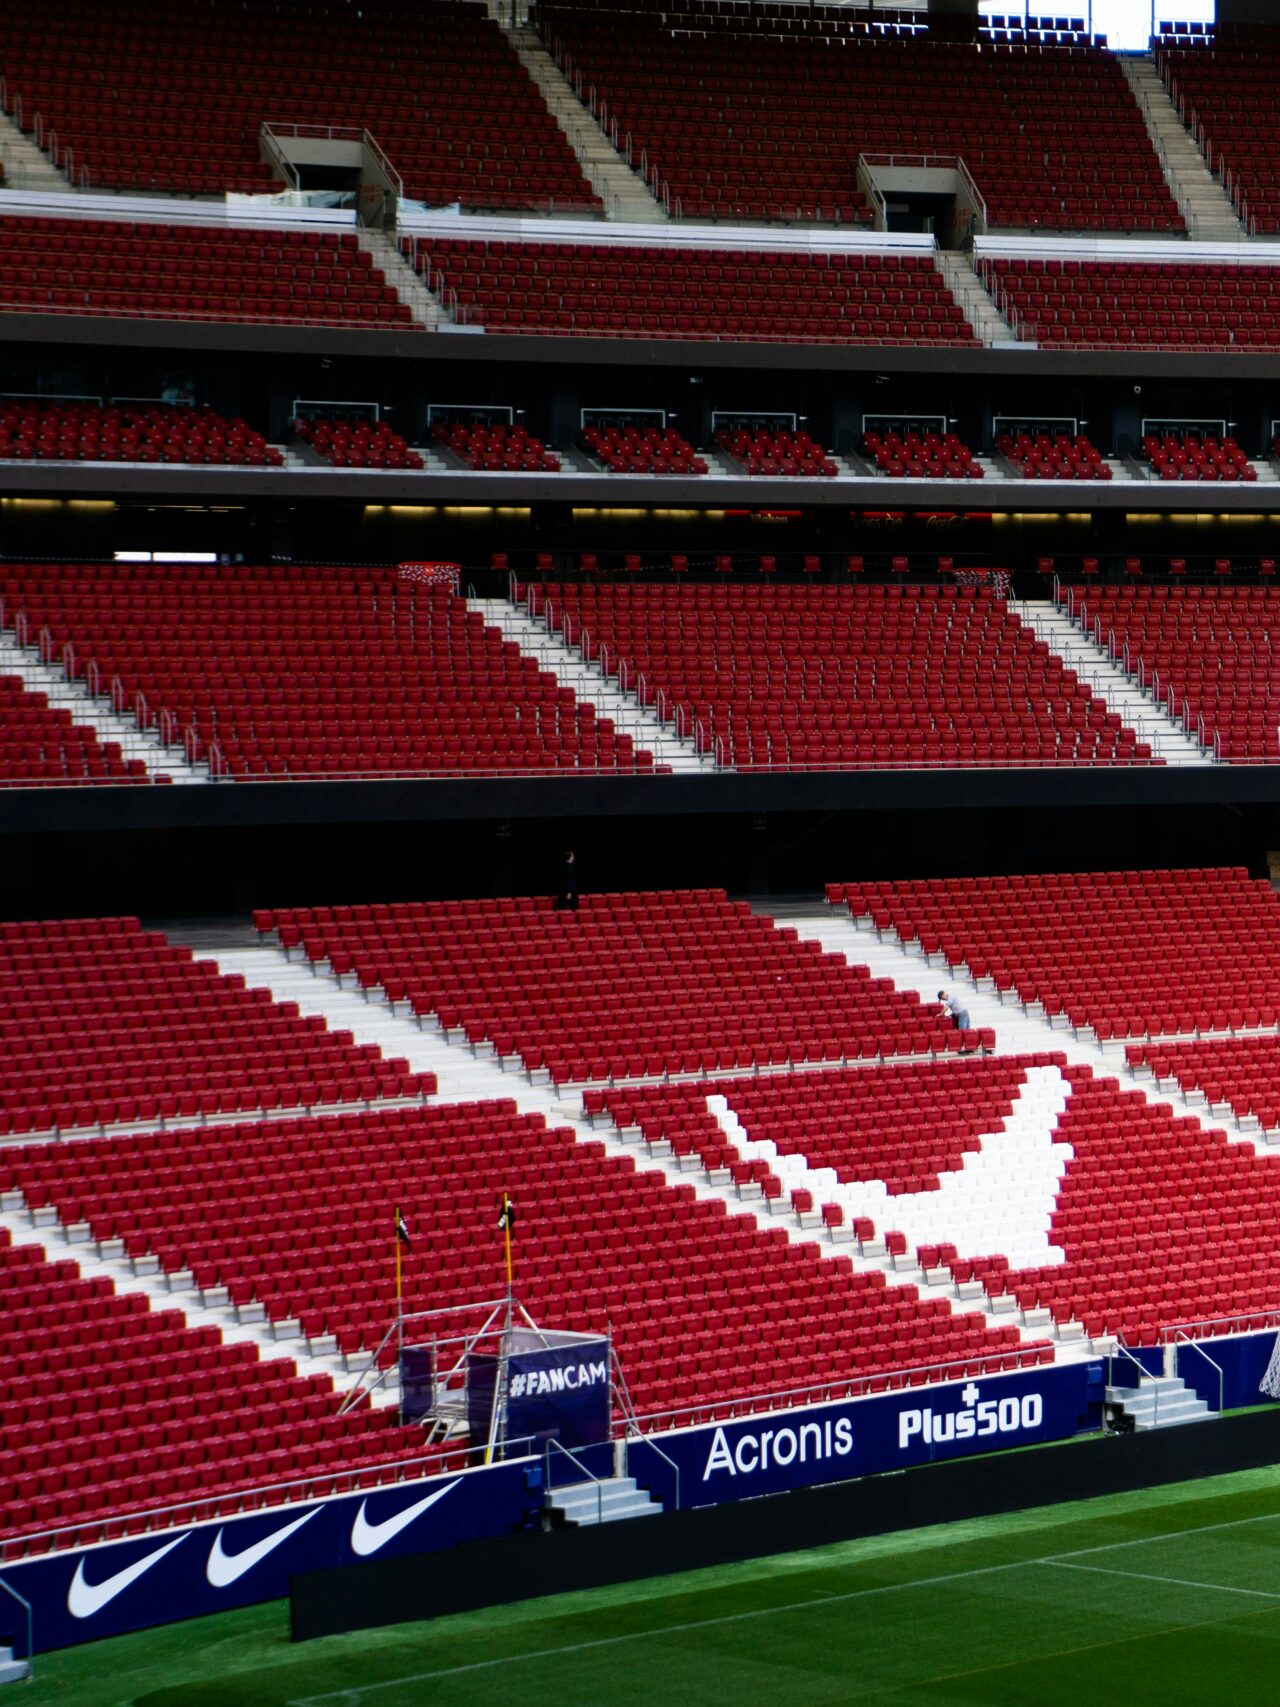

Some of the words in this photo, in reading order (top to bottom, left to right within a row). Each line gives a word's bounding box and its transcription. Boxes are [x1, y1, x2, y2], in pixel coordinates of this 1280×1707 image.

[510, 1361, 606, 1397] #FANCAM
[899, 1392, 1043, 1449] Plus500
[702, 1417, 854, 1482] Acronis
